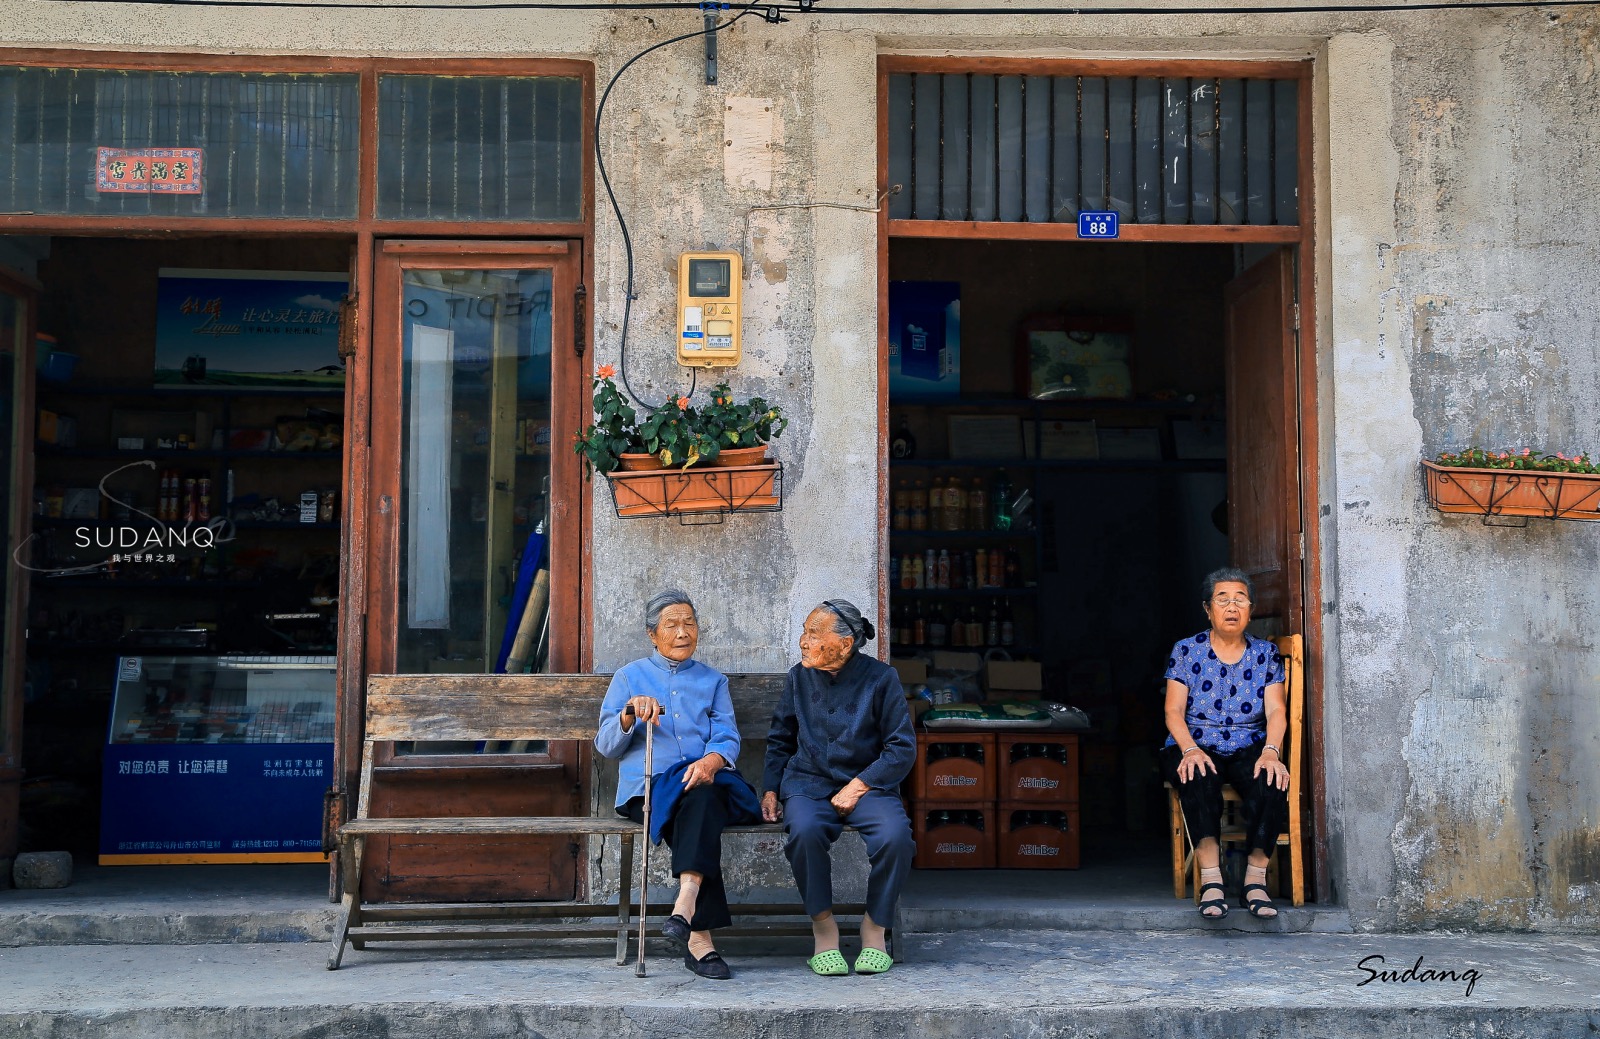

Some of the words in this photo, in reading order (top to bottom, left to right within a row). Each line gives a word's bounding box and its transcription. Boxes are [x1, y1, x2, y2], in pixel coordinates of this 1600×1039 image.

[1090, 222, 1107, 234] 88
[241, 308, 339, 325] 让心灵去旅行
[118, 760, 170, 774] 对您负责
[178, 759, 228, 774] 让您满意
[933, 775, 977, 786] ABInBev
[1018, 777, 1059, 788] ABInBev
